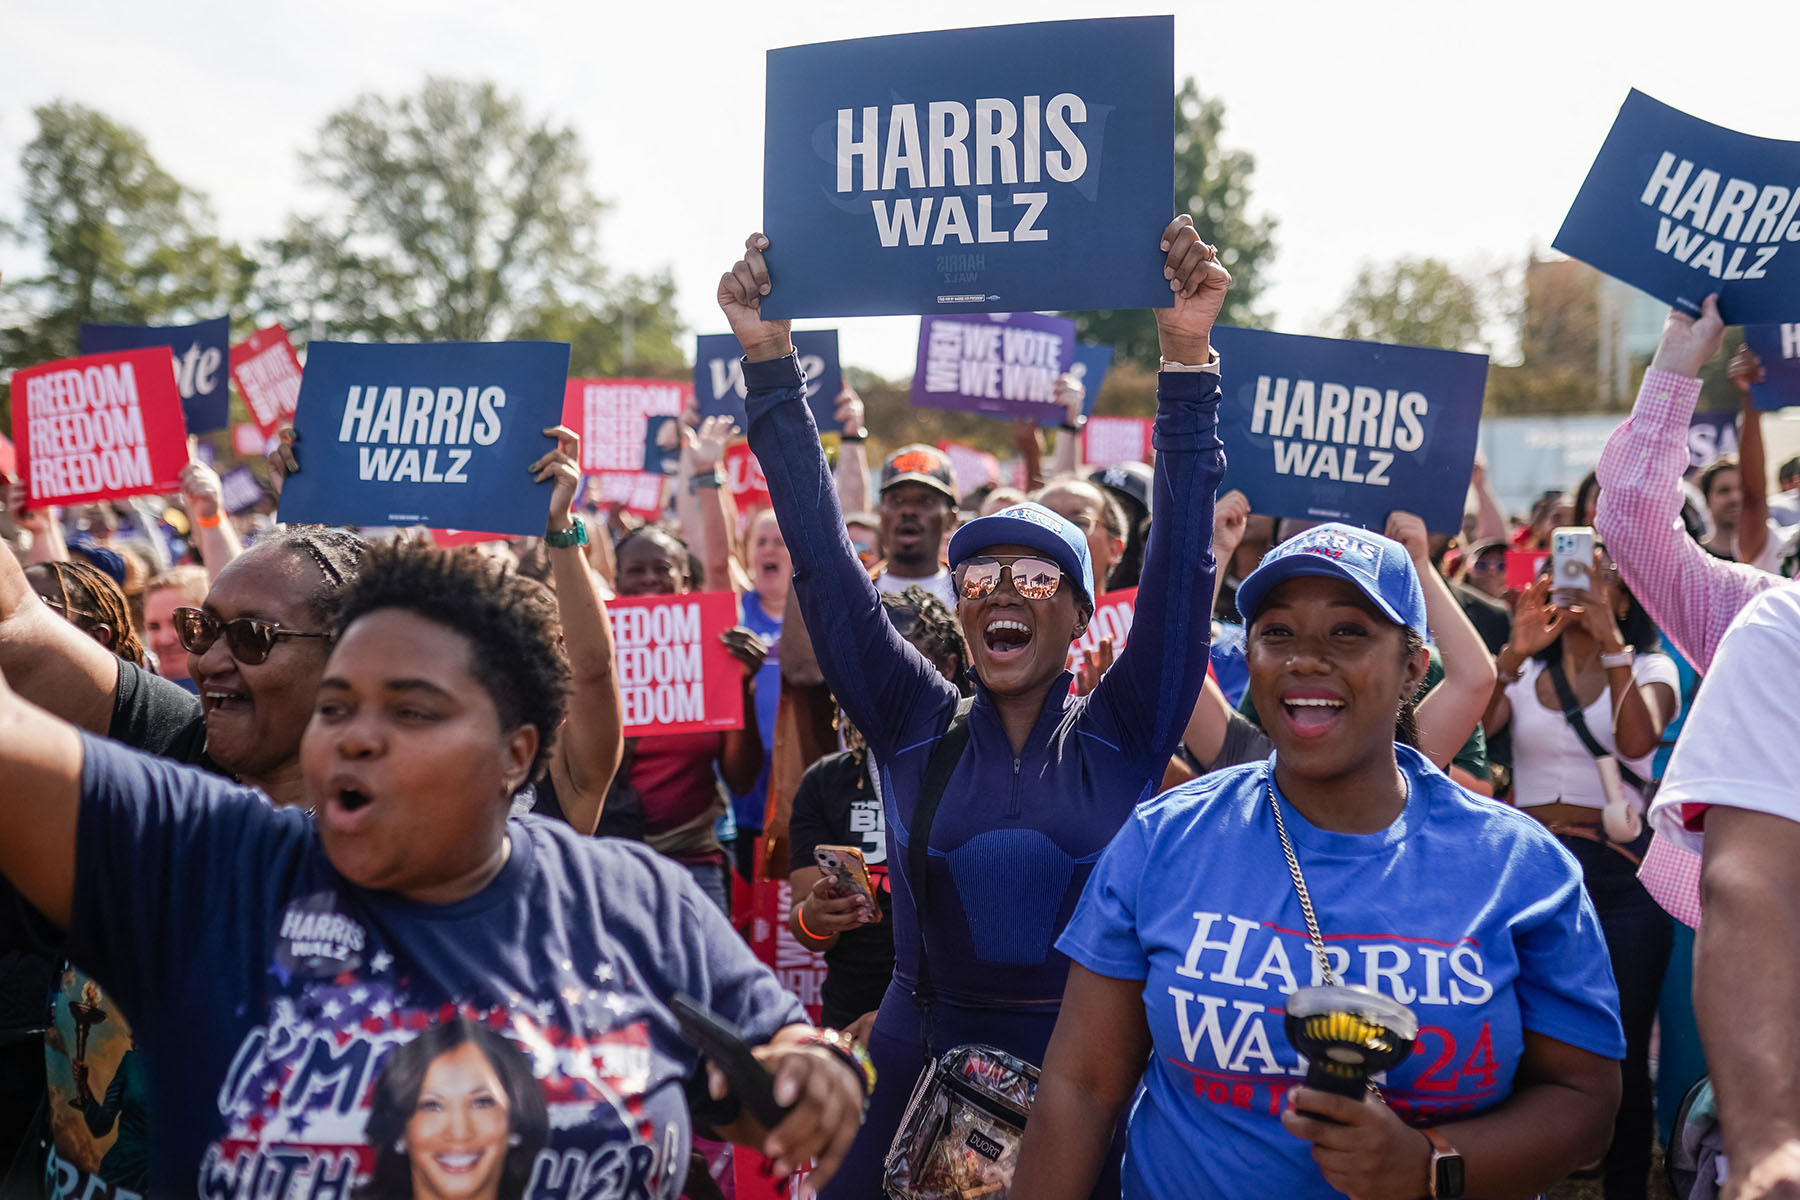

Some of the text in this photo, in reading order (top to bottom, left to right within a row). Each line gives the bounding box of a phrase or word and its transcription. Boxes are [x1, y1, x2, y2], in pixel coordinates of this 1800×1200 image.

[837, 92, 1088, 193] HARRIS
[871, 191, 1049, 247] WALZ
[1655, 216, 1780, 281] WALZ
[171, 341, 222, 399] te
[961, 323, 1063, 371] WE VOTE
[27, 361, 140, 418] FREEDOM
[959, 359, 1001, 399] WE
[28, 404, 146, 461] FREEDOM
[338, 385, 507, 446] HARRIS
[583, 415, 648, 444] FREED
[1250, 375, 1429, 453] HARRIS
[358, 446, 473, 484] WALZ
[1273, 439, 1395, 487] WALZ
[1688, 422, 1741, 468] SA
[30, 445, 153, 500] FREEDOM
[607, 602, 701, 648] EDOM
[615, 643, 704, 687] EDOM
[620, 682, 705, 726] EDOM
[280, 910, 366, 952] HARRIS
[291, 940, 350, 961] WALZ
[1176, 911, 1494, 1005] HARRIS
[1167, 986, 1311, 1077] WA
[1193, 1074, 1254, 1108] FOR
[969, 1133, 1001, 1158] DUORT
